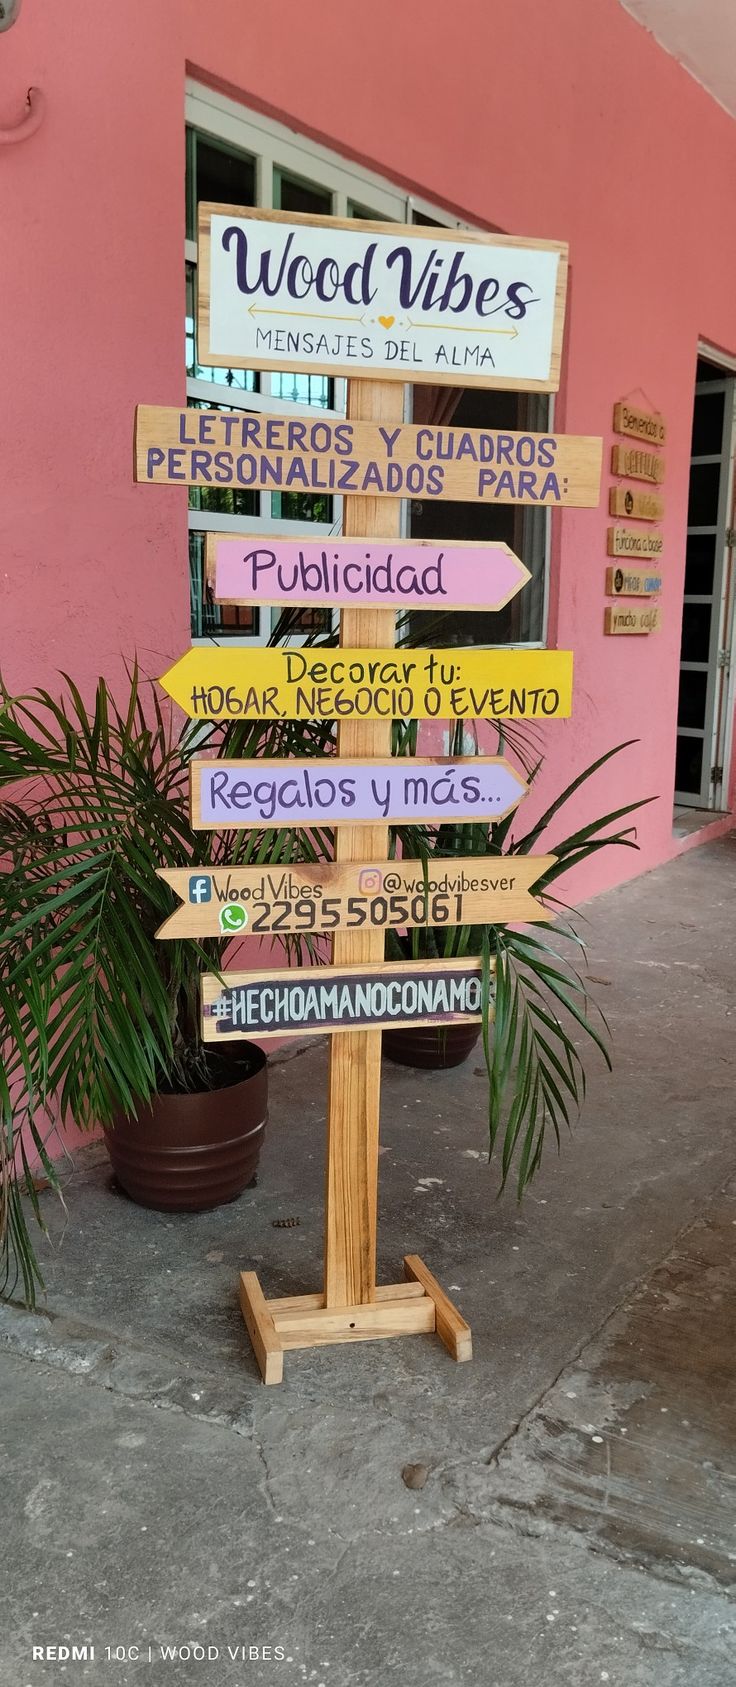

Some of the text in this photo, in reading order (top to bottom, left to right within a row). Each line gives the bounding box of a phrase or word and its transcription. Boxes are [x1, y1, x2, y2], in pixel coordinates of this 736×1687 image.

[222, 226, 541, 320] Wood Vibes
[256, 328, 495, 368] MENSAJES DEL ALMA
[179, 413, 557, 467] LETREROS Y CUADROS
[147, 448, 569, 500] PERSONALIZADOS PARA:
[243, 549, 447, 596] Publicidad
[282, 651, 461, 685] Decorar tu:
[191, 686, 560, 717] HOGAR, NEGOCIO O EVENTO
[210, 769, 501, 819] Regalos y más...
[212, 873, 323, 903] Wood Vibes
[251, 893, 462, 932] 2295505061
